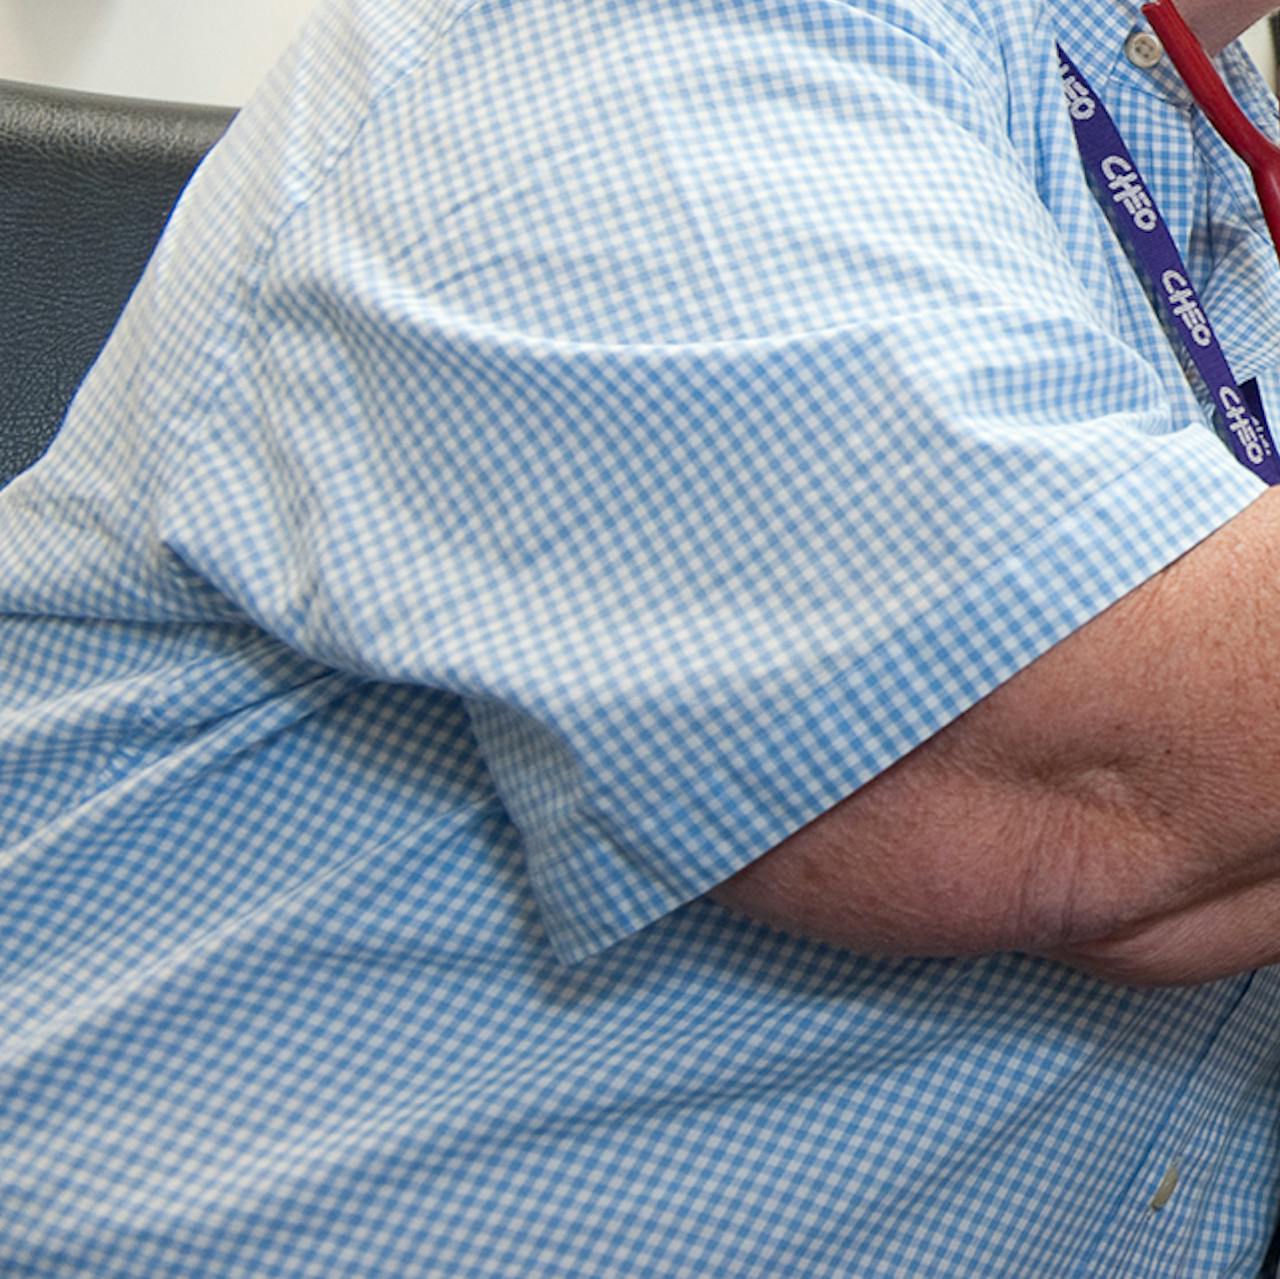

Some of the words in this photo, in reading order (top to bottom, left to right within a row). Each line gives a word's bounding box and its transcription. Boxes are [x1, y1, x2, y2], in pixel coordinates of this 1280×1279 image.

[1101, 154, 1156, 231] CHEO
[1162, 270, 1210, 346] CHEO
[1219, 386, 1265, 465] CHEO
